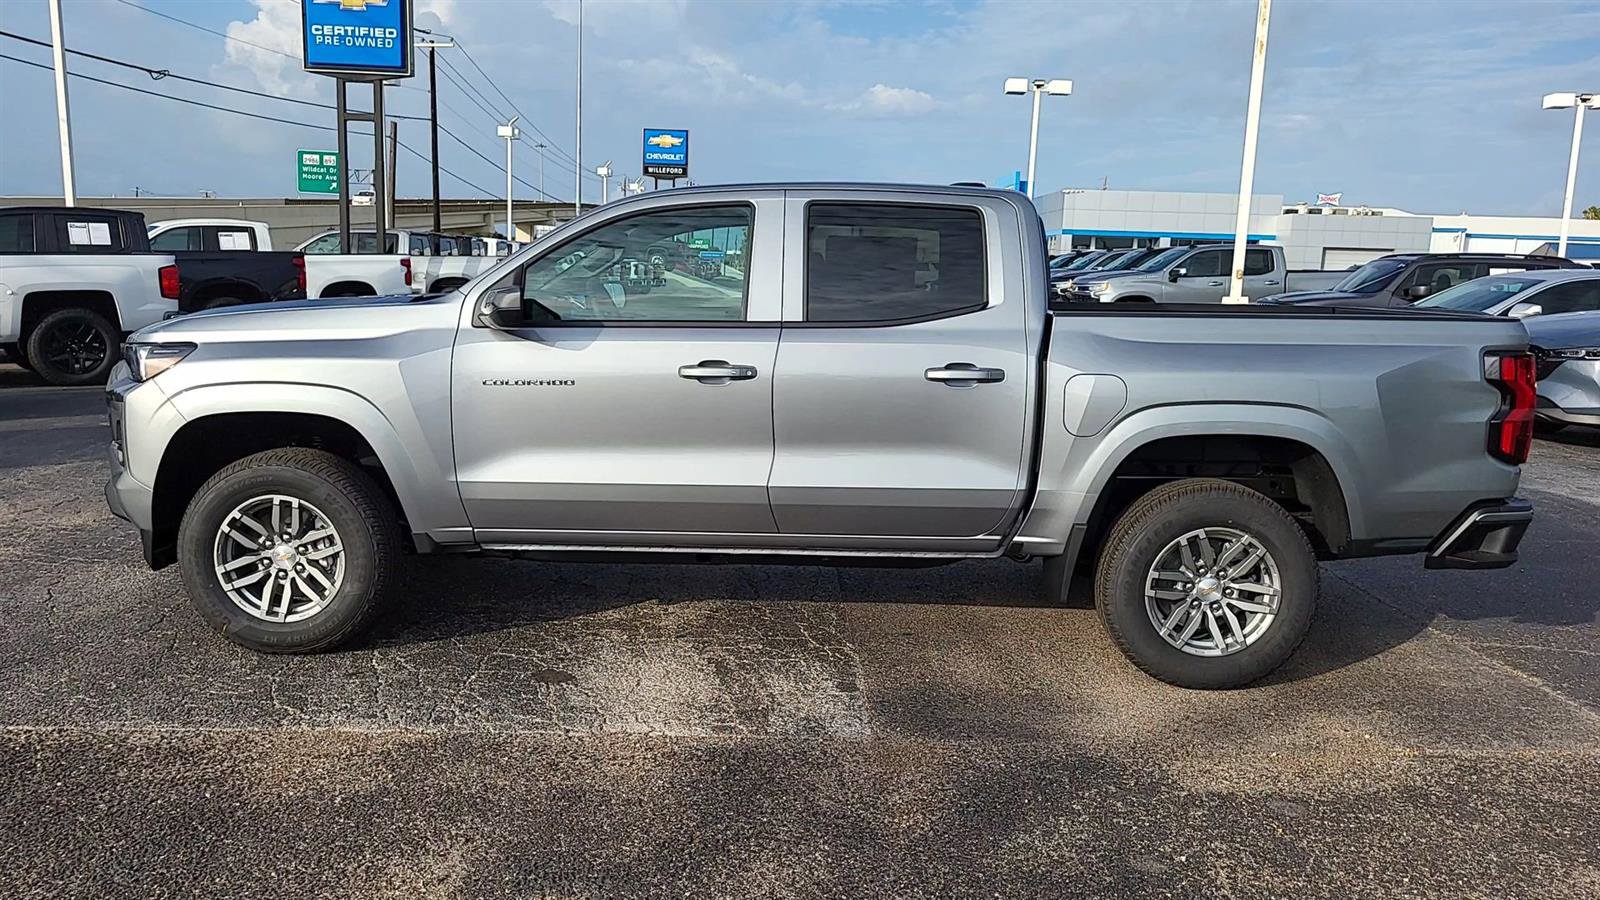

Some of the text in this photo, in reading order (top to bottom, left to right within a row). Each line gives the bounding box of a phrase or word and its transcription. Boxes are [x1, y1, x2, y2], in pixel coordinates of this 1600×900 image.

[311, 24, 397, 38] CERTIFIED
[316, 36, 393, 48] PRE-OWNED
[646, 152, 685, 160] CHEVROLET
